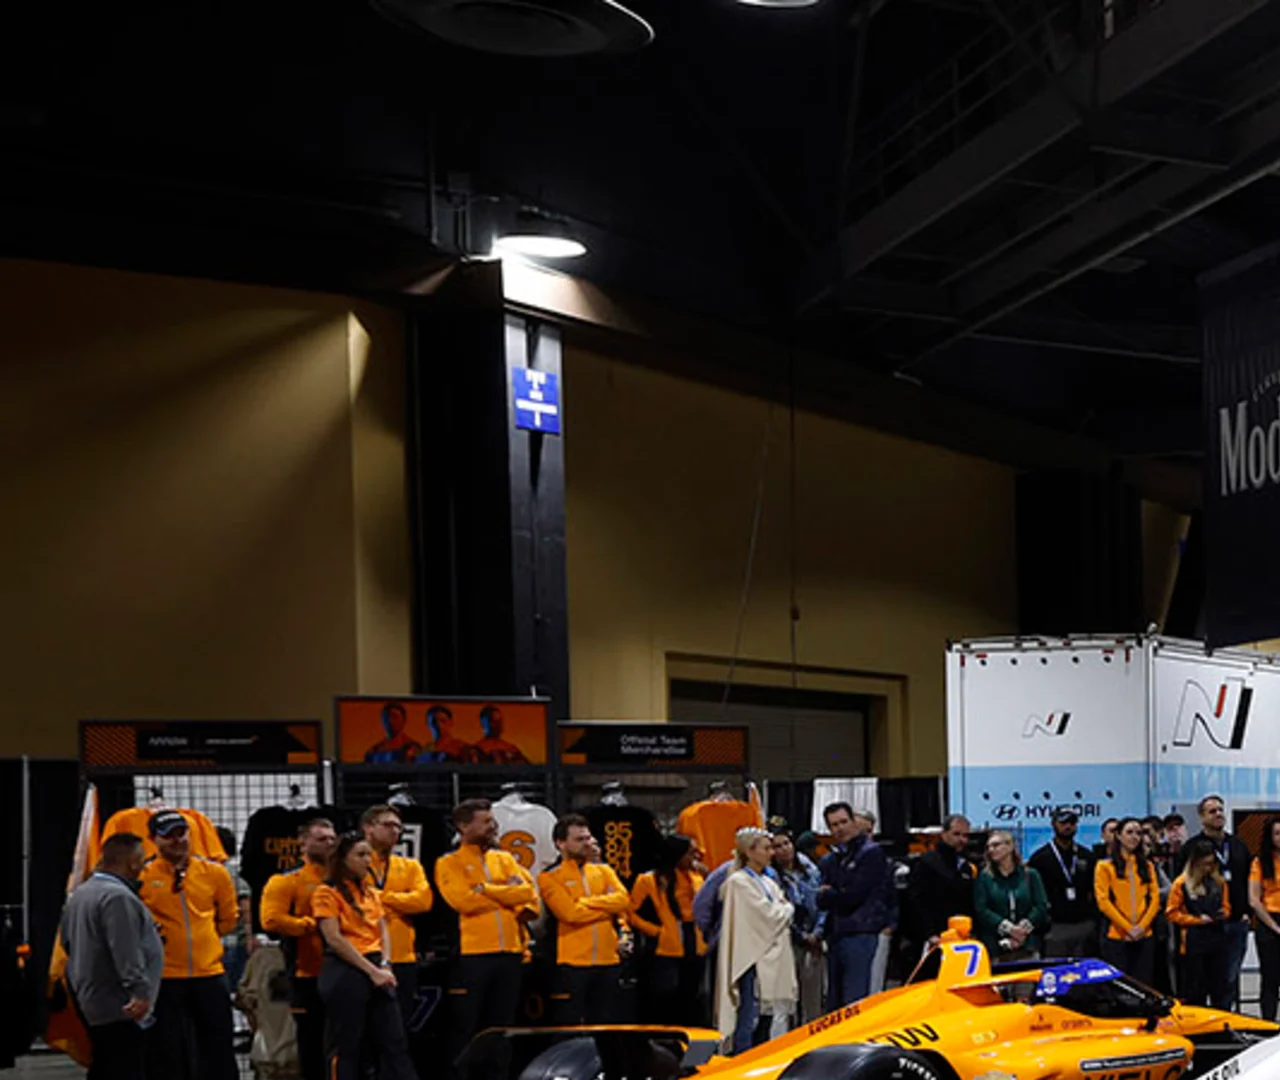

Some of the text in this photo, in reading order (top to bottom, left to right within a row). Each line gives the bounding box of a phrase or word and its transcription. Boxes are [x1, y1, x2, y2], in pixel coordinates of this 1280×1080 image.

[500, 830, 536, 870] 6
[953, 944, 980, 976] 7
[809, 1013, 843, 1036] LUCAS
